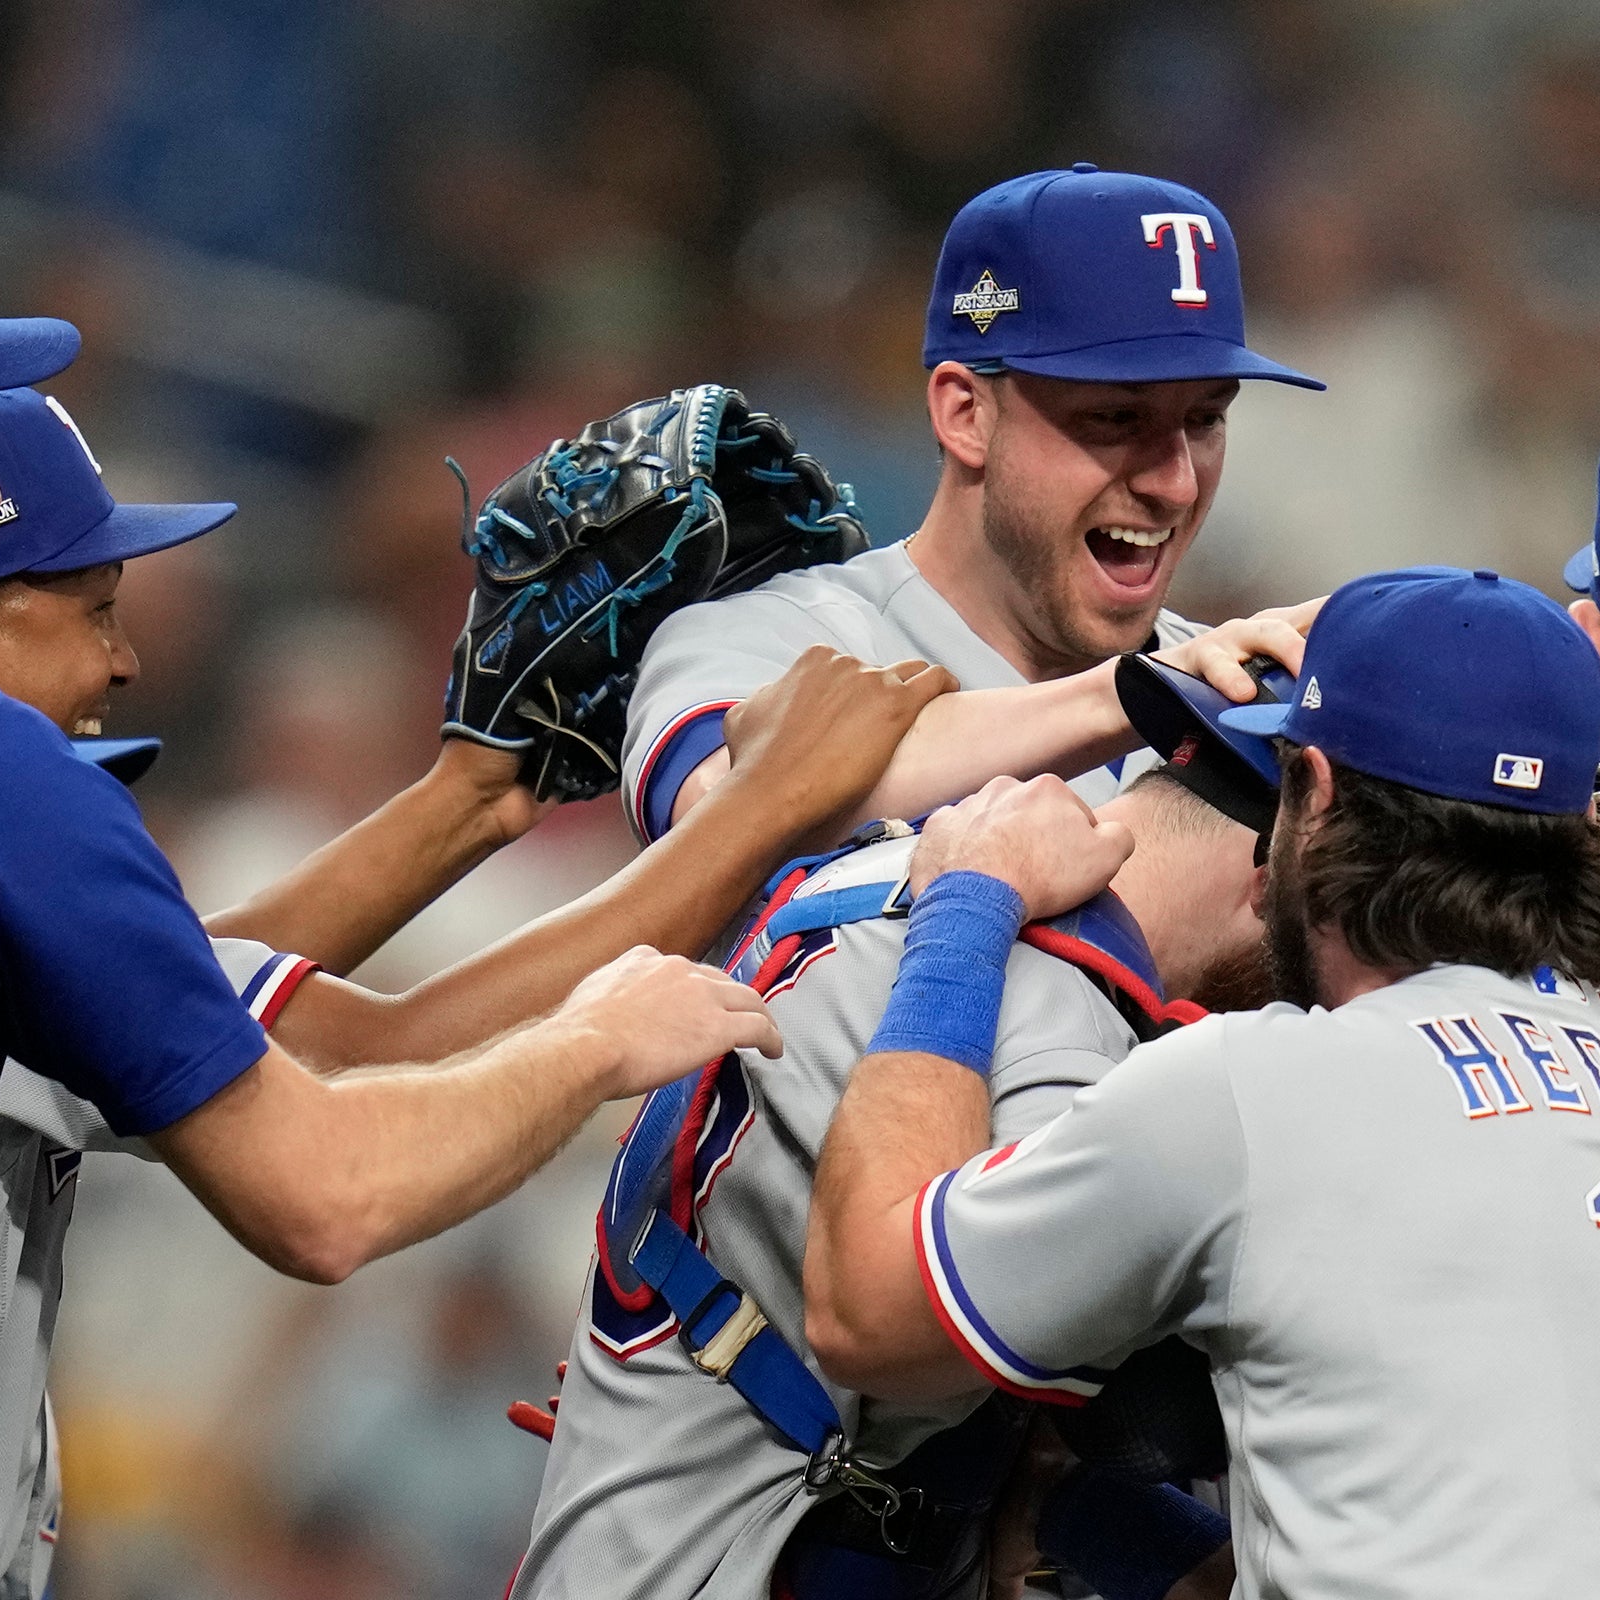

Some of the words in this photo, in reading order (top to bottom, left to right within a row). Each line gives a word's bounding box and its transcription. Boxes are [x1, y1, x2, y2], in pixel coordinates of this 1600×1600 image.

[1140, 212, 1217, 309] T
[953, 291, 1019, 312] POSTSEASON
[539, 559, 614, 636] LIAM
